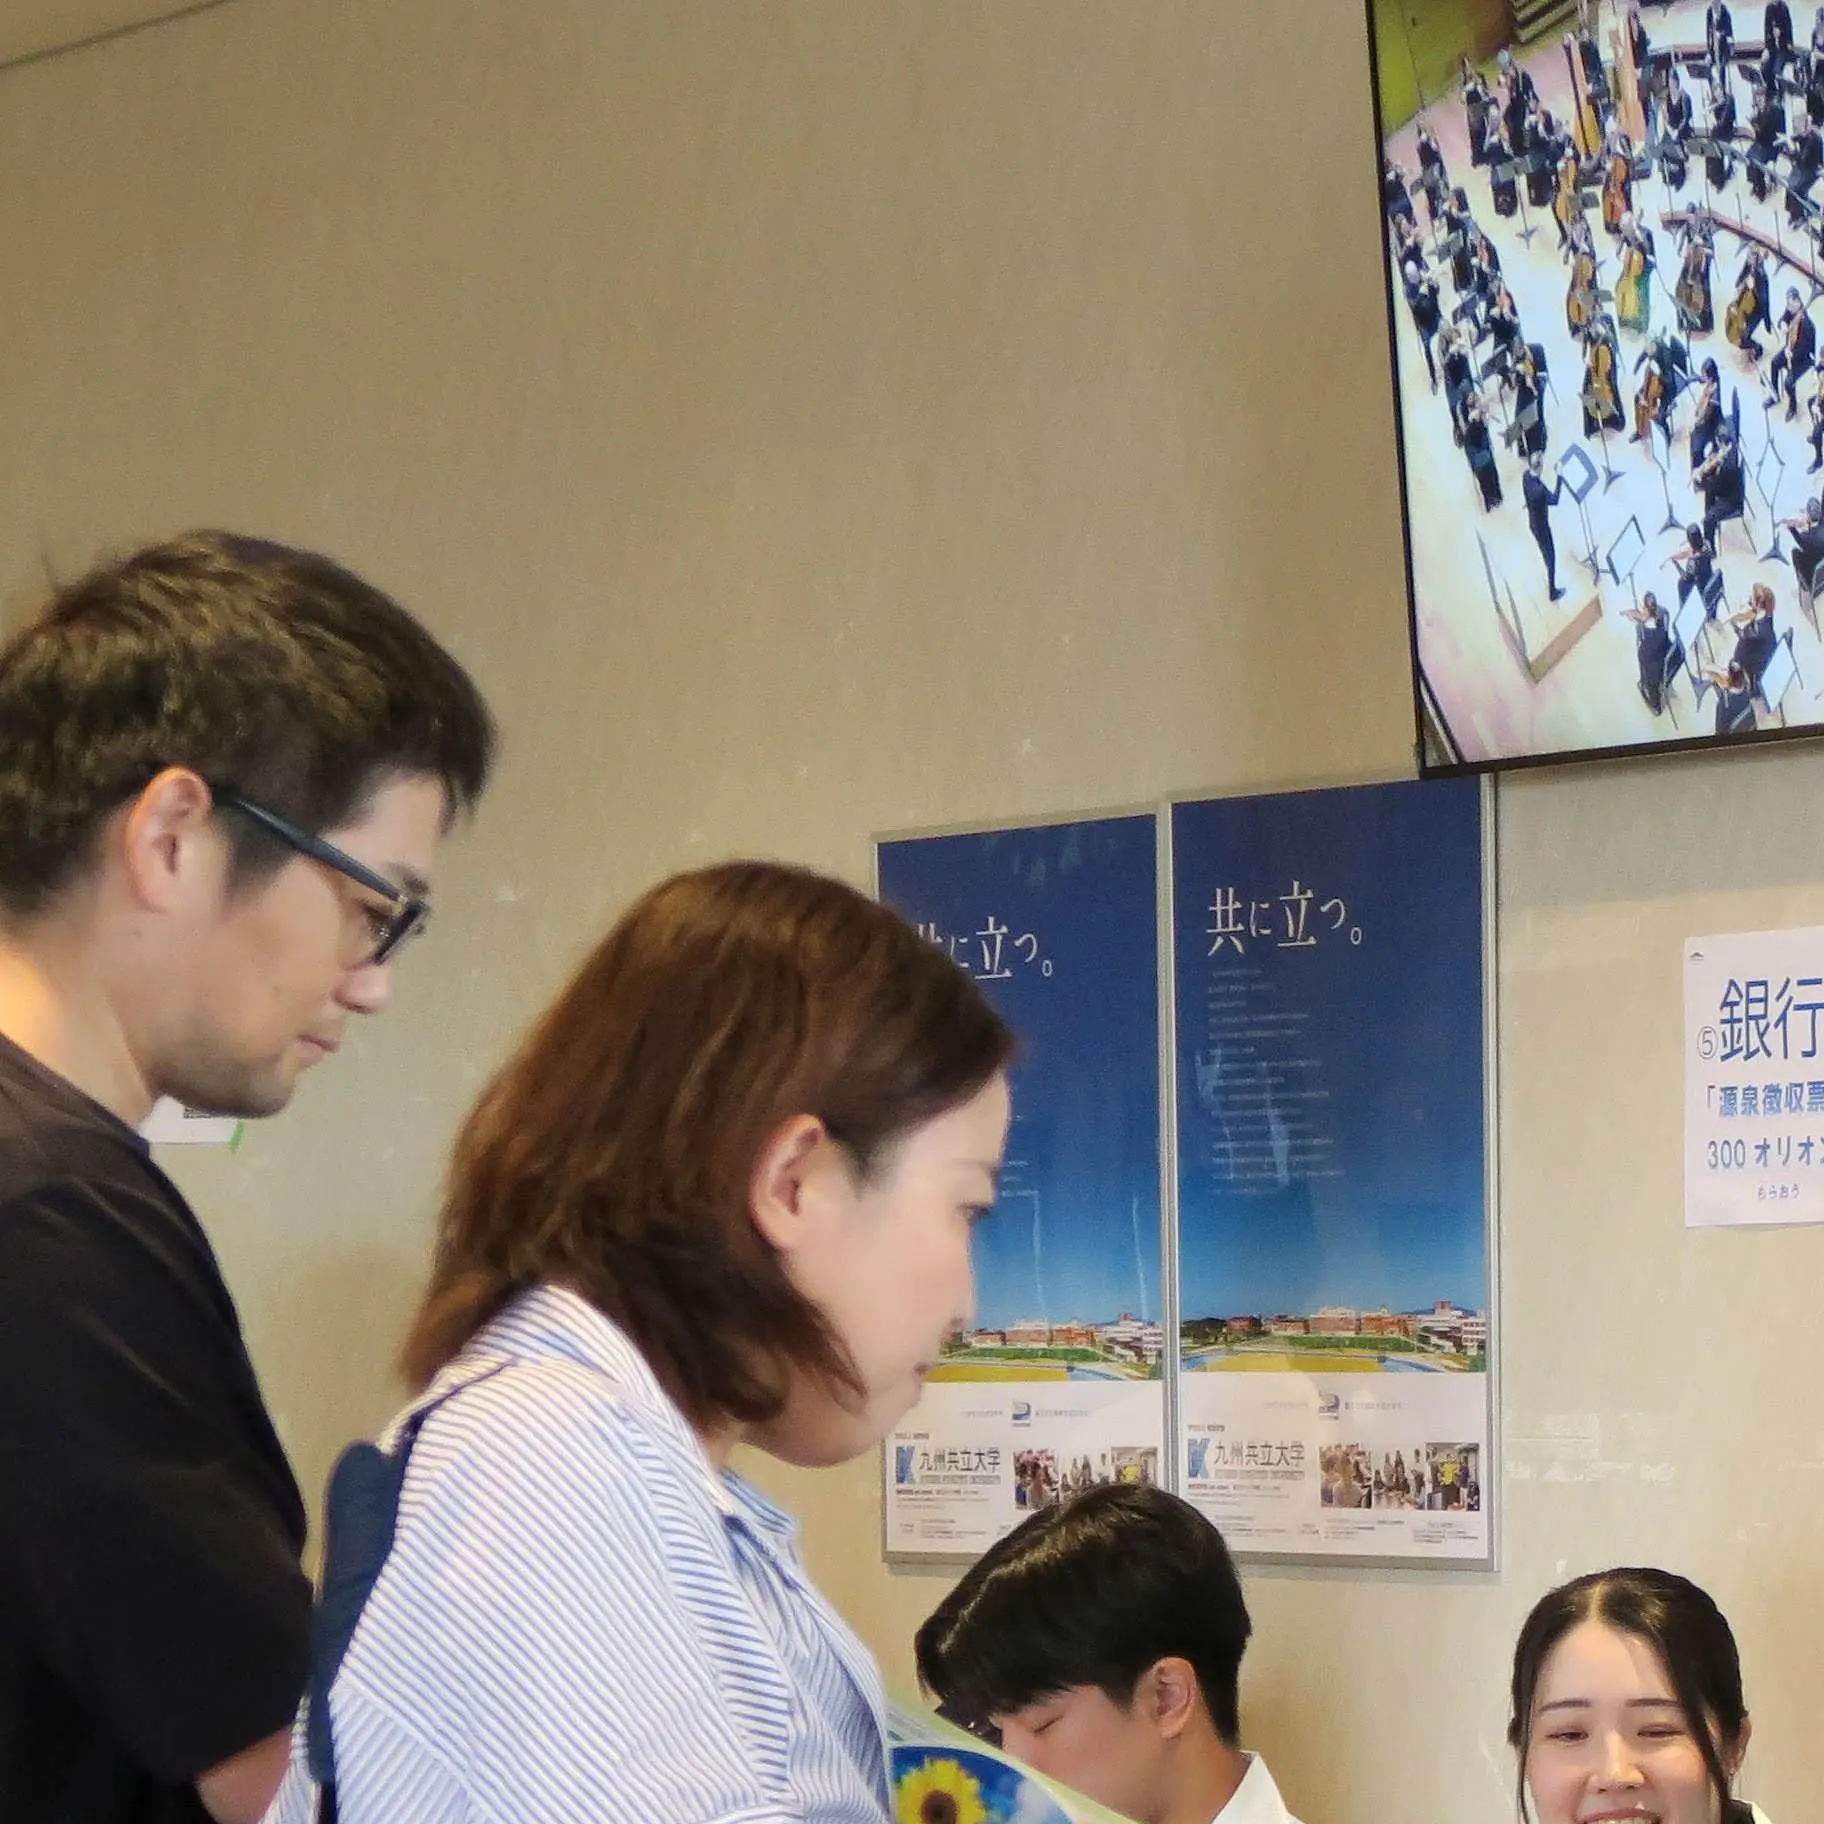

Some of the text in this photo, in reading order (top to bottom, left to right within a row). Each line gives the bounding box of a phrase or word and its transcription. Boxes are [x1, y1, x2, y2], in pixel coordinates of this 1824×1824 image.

[1206, 881, 1362, 956] 共に立つ。
[1757, 1184, 1800, 1200] もらおう
[920, 1447, 1000, 1472] 九州共立大学
[1214, 1442, 1305, 1467] 九州共立大学
